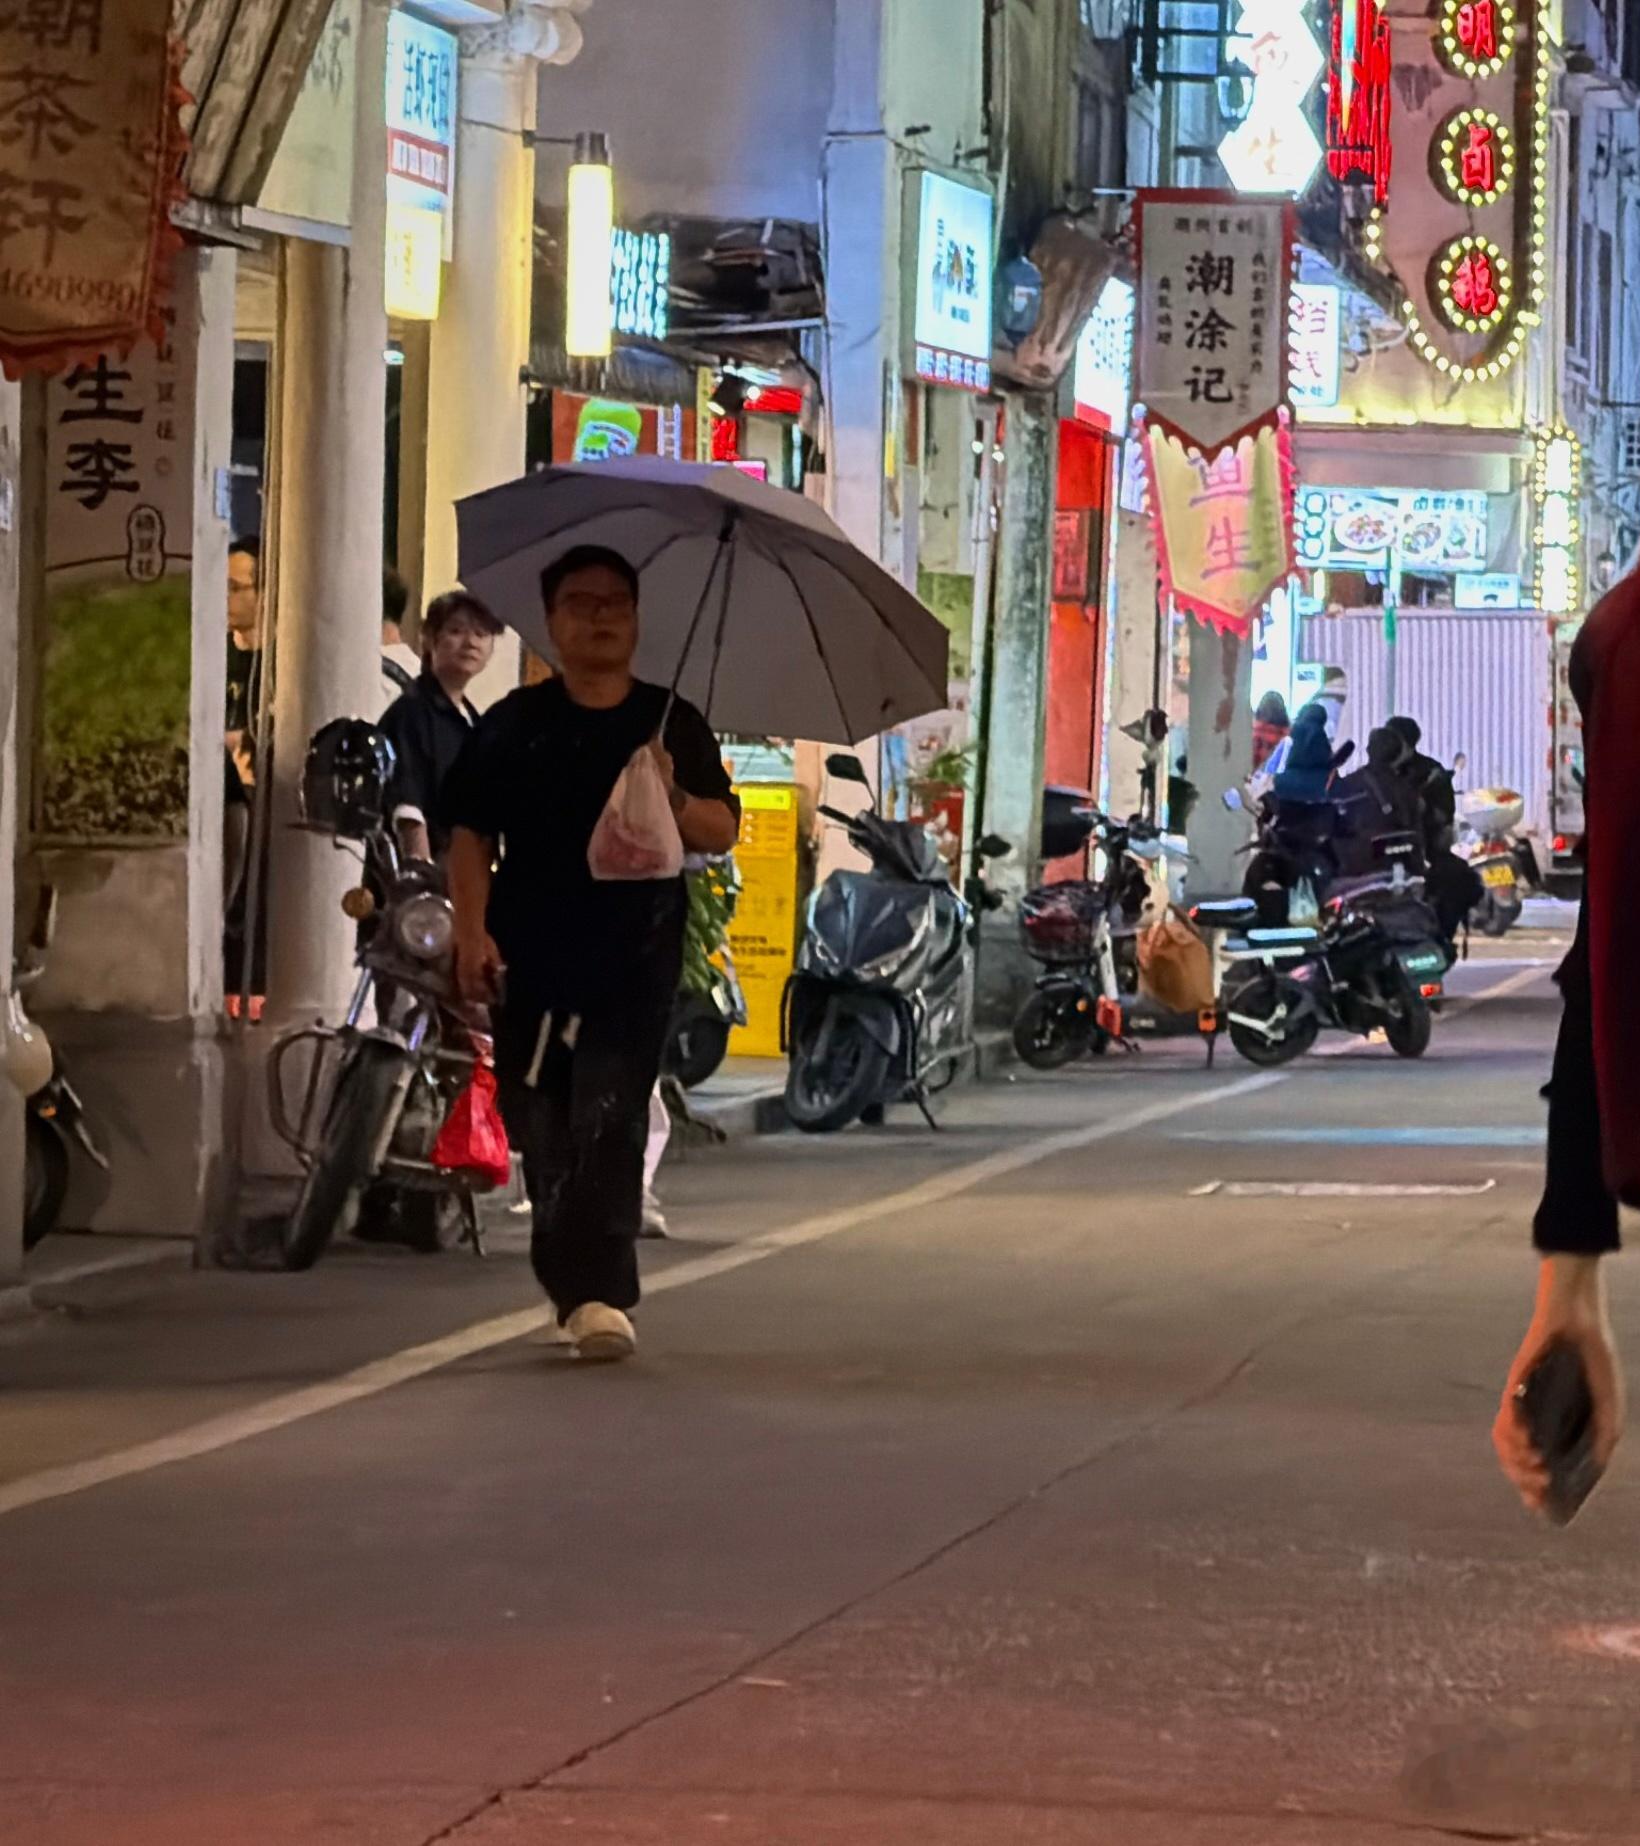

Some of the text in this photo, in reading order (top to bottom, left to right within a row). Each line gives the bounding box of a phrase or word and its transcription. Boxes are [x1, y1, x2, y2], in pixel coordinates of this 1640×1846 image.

[1184, 250, 1238, 404] 潮涂记
[58, 353, 144, 510] 生李
